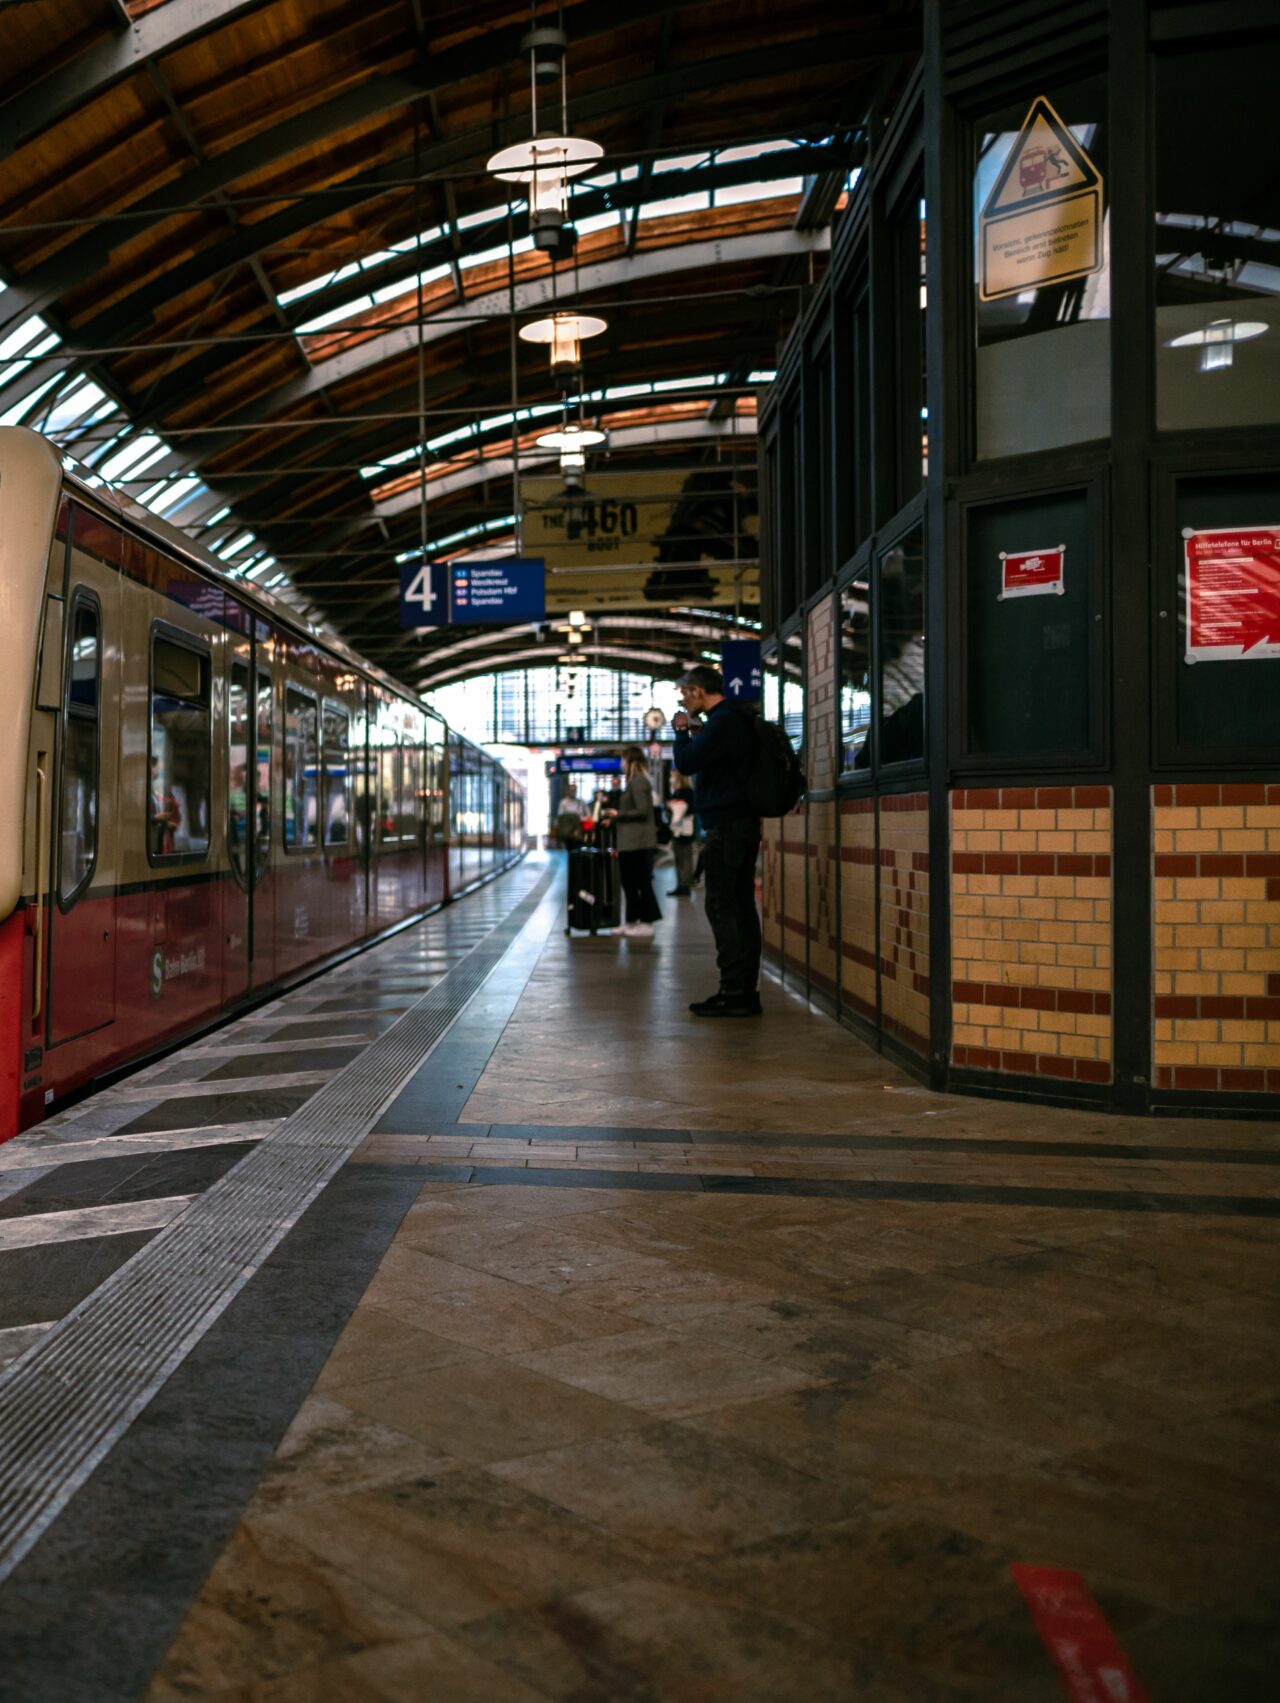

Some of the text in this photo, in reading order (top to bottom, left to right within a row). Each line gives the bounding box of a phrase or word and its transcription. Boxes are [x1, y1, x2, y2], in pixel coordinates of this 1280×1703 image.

[1033, 241, 1046, 250] erst
[1048, 232, 1079, 246] betreten
[1037, 249, 1052, 260] Zug
[1252, 538, 1272, 546] Berlin
[471, 568, 504, 579] Spandau
[404, 564, 438, 612] 4
[471, 597, 504, 607] Spandau
[153, 953, 162, 993] S
